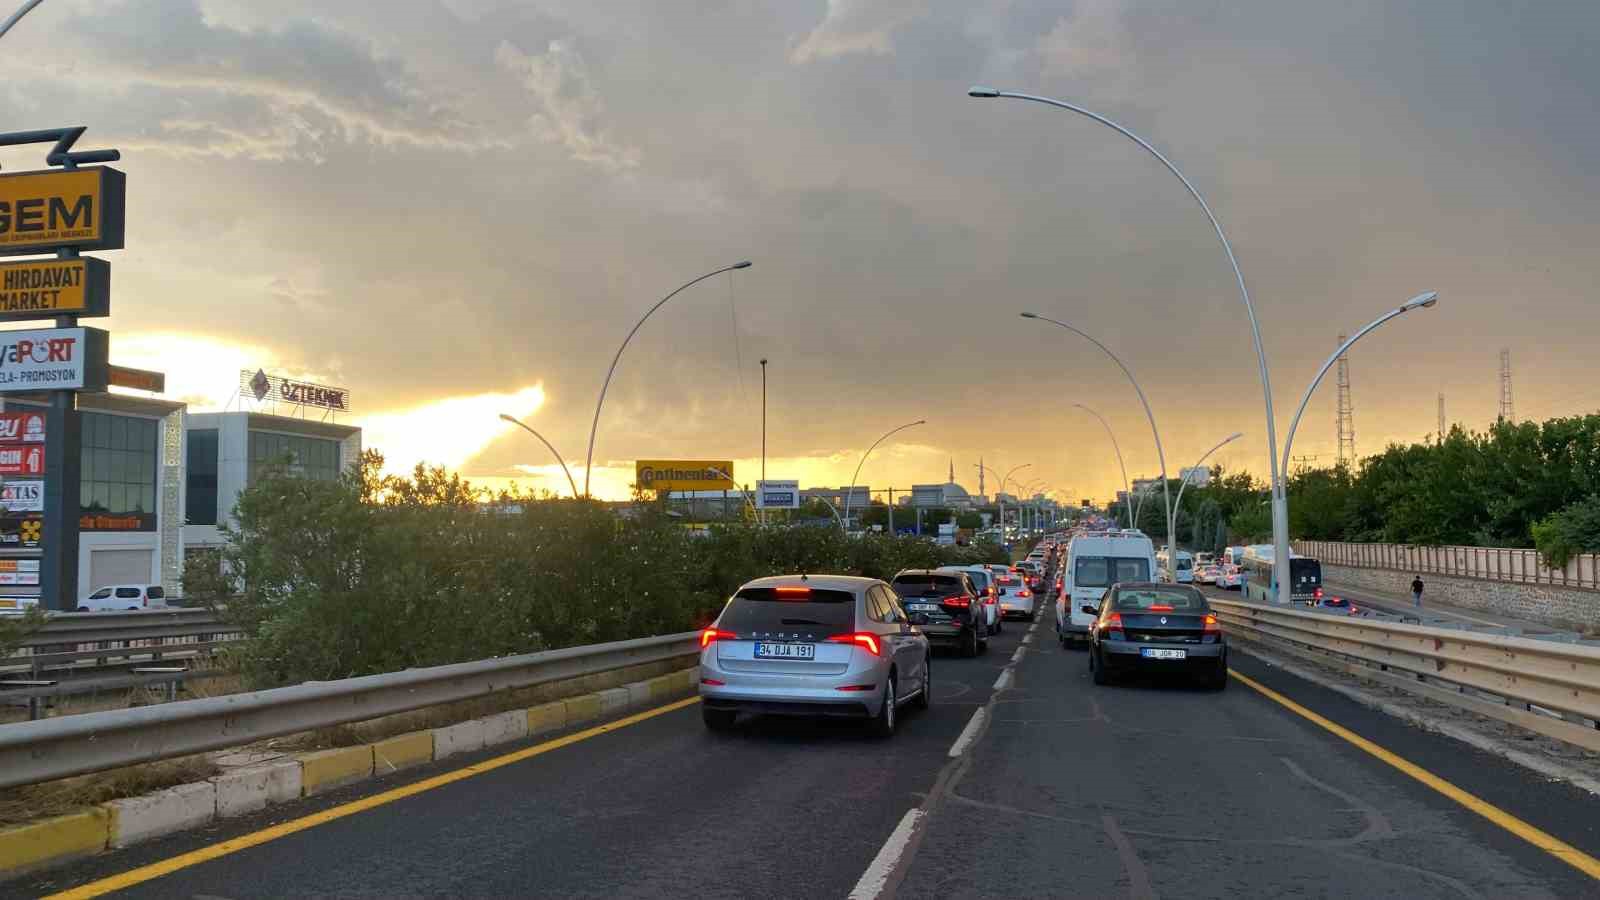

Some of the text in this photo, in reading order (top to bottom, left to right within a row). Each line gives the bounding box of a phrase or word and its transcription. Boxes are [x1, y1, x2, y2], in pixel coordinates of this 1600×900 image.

[4, 266, 83, 290] HIRDAVAT
[0, 290, 60, 311] MARKET
[760, 644, 771, 655] 34
[797, 646, 811, 657] 191
